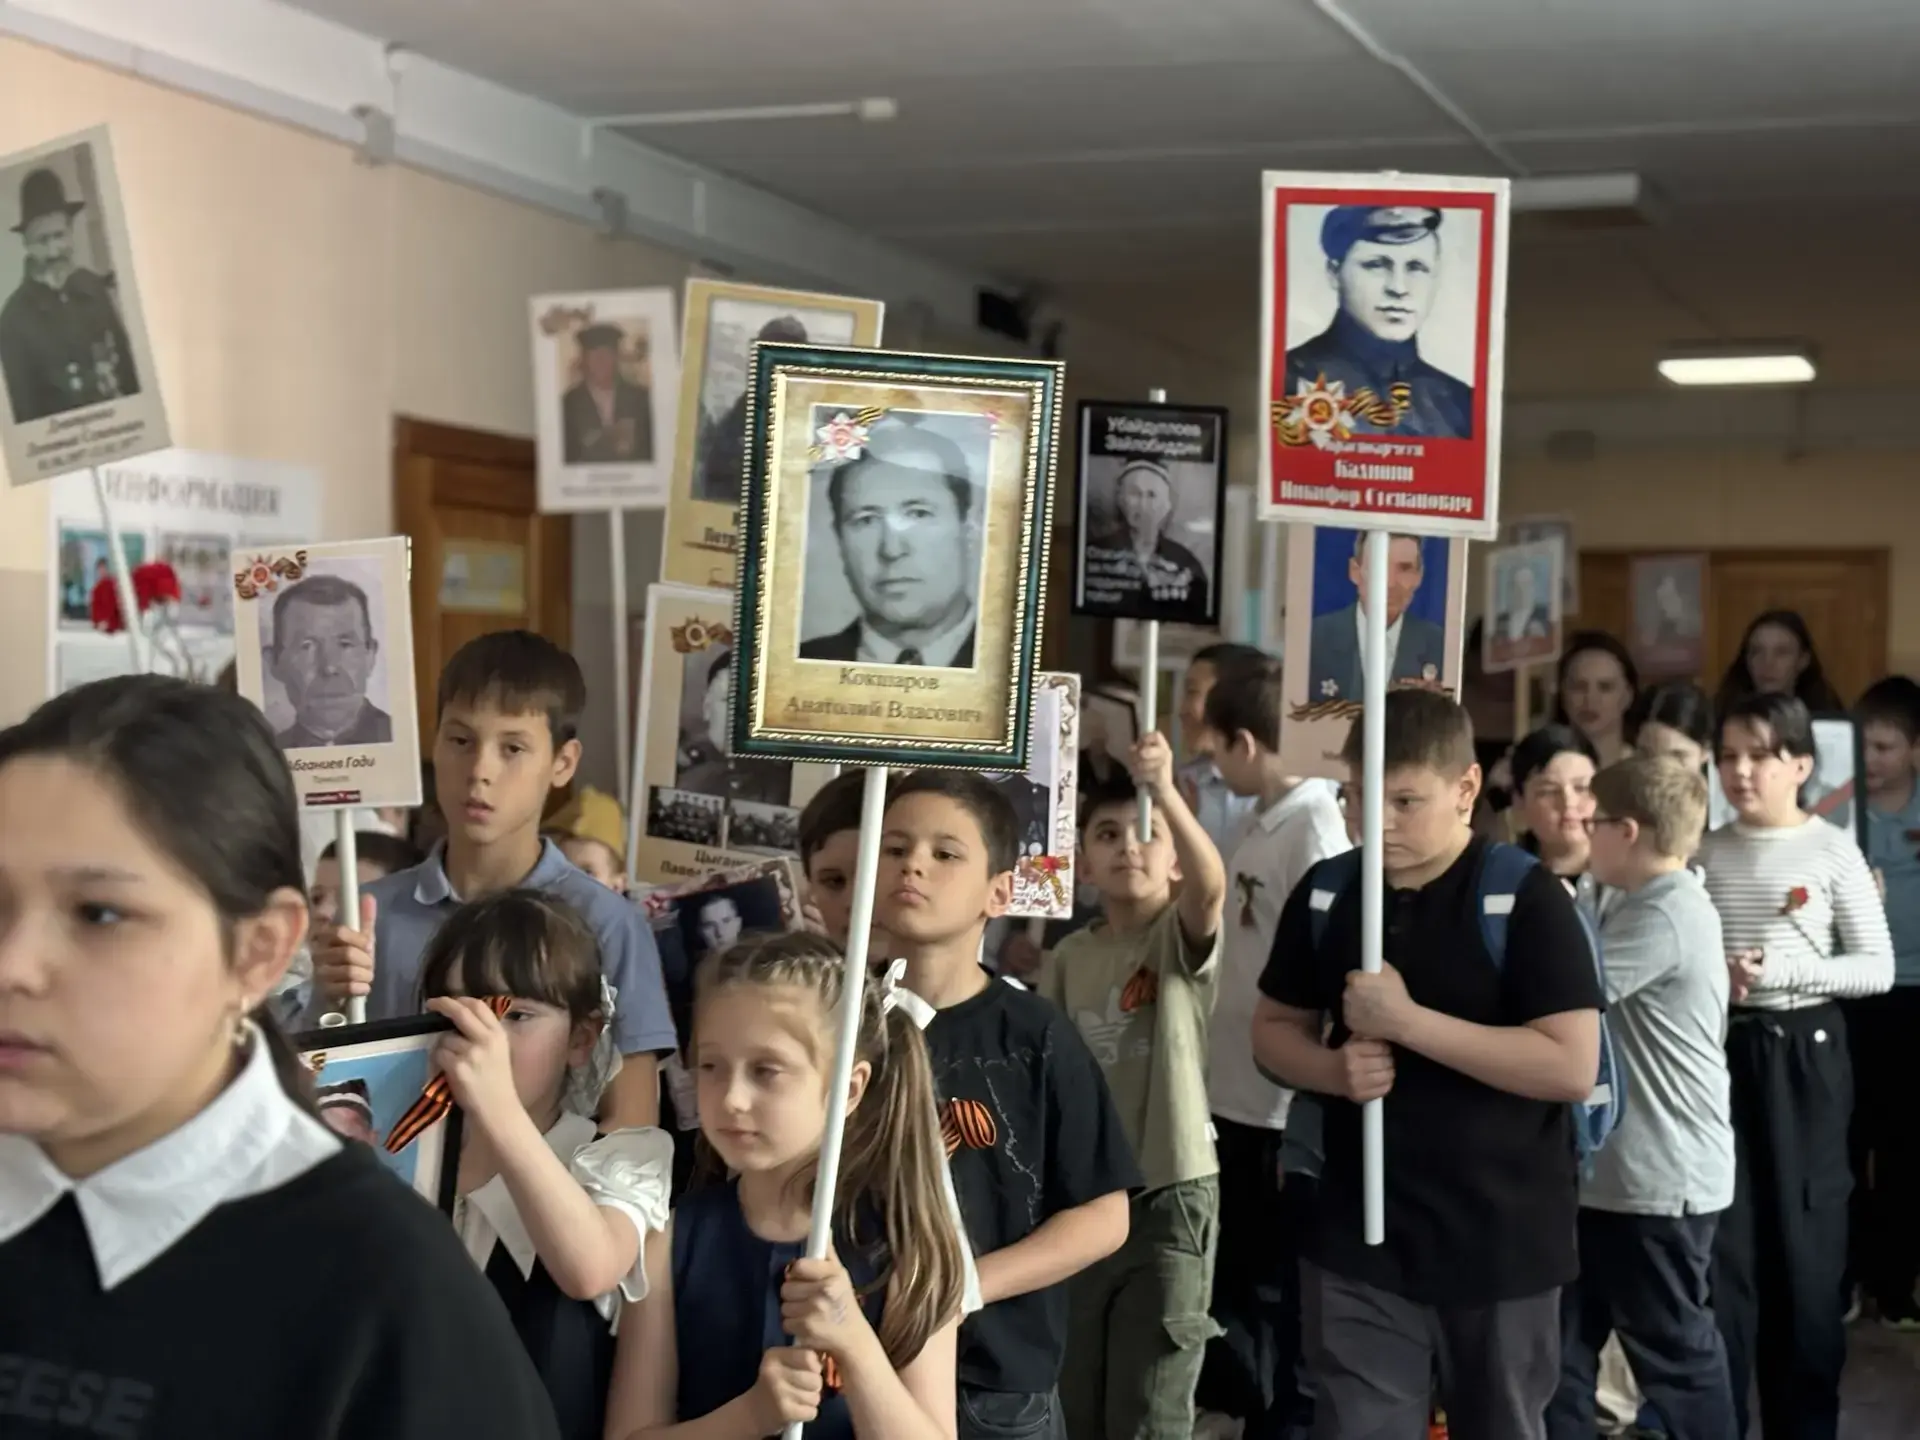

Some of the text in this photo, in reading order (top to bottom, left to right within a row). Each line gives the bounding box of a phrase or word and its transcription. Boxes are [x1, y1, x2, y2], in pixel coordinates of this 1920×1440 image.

[1334, 458, 1414, 482] Калинин
[1364, 487, 1473, 513] Степанович
[838, 667, 940, 692] Кокшаров
[784, 696, 983, 723] Анатолий Власович
